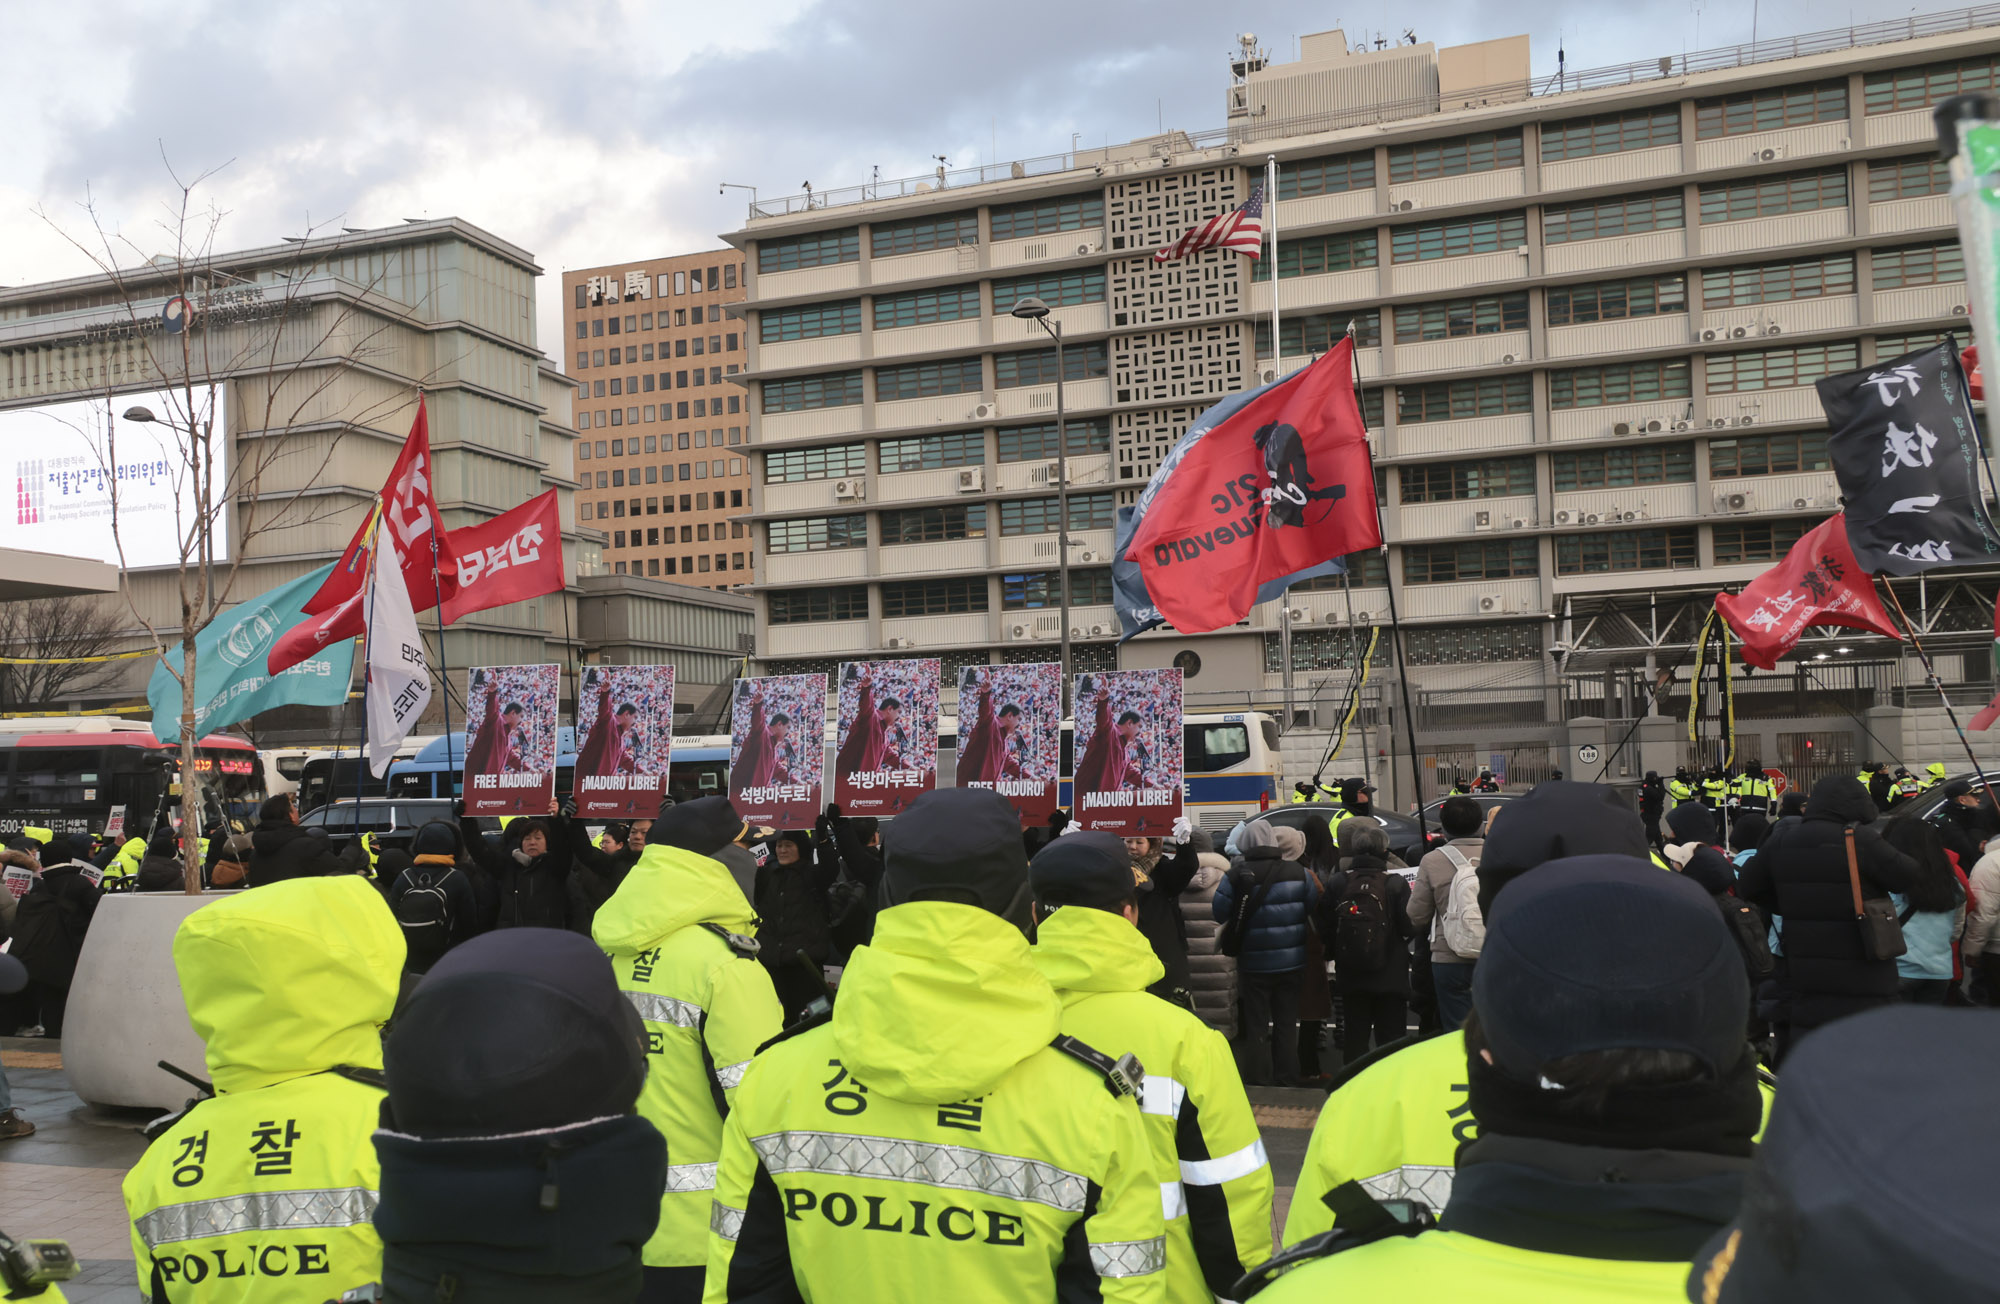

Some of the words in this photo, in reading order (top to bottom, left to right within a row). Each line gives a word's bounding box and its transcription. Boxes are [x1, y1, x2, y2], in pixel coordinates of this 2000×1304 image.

[586, 269, 646, 301] 利馬
[49, 500, 83, 511] Presidential
[57, 510, 78, 521] Ageing
[79, 508, 102, 519] Society
[148, 502, 167, 512] Policy
[474, 774, 497, 789] FREE
[499, 773, 542, 788] MADURO!
[581, 775, 626, 793] ¡MADURO
[628, 776, 660, 790] LIBRE!
[847, 769, 924, 789] 석방마두로!
[739, 785, 811, 805] 석방마두로!
[996, 781, 1045, 797] MADURO!
[1082, 790, 1133, 811] ¡MADURO
[1136, 789, 1173, 806] LIBRE!
[67, 819, 88, 828] 서울역
[784, 1187, 1025, 1246] POLICE
[157, 1244, 330, 1284] POLICE
